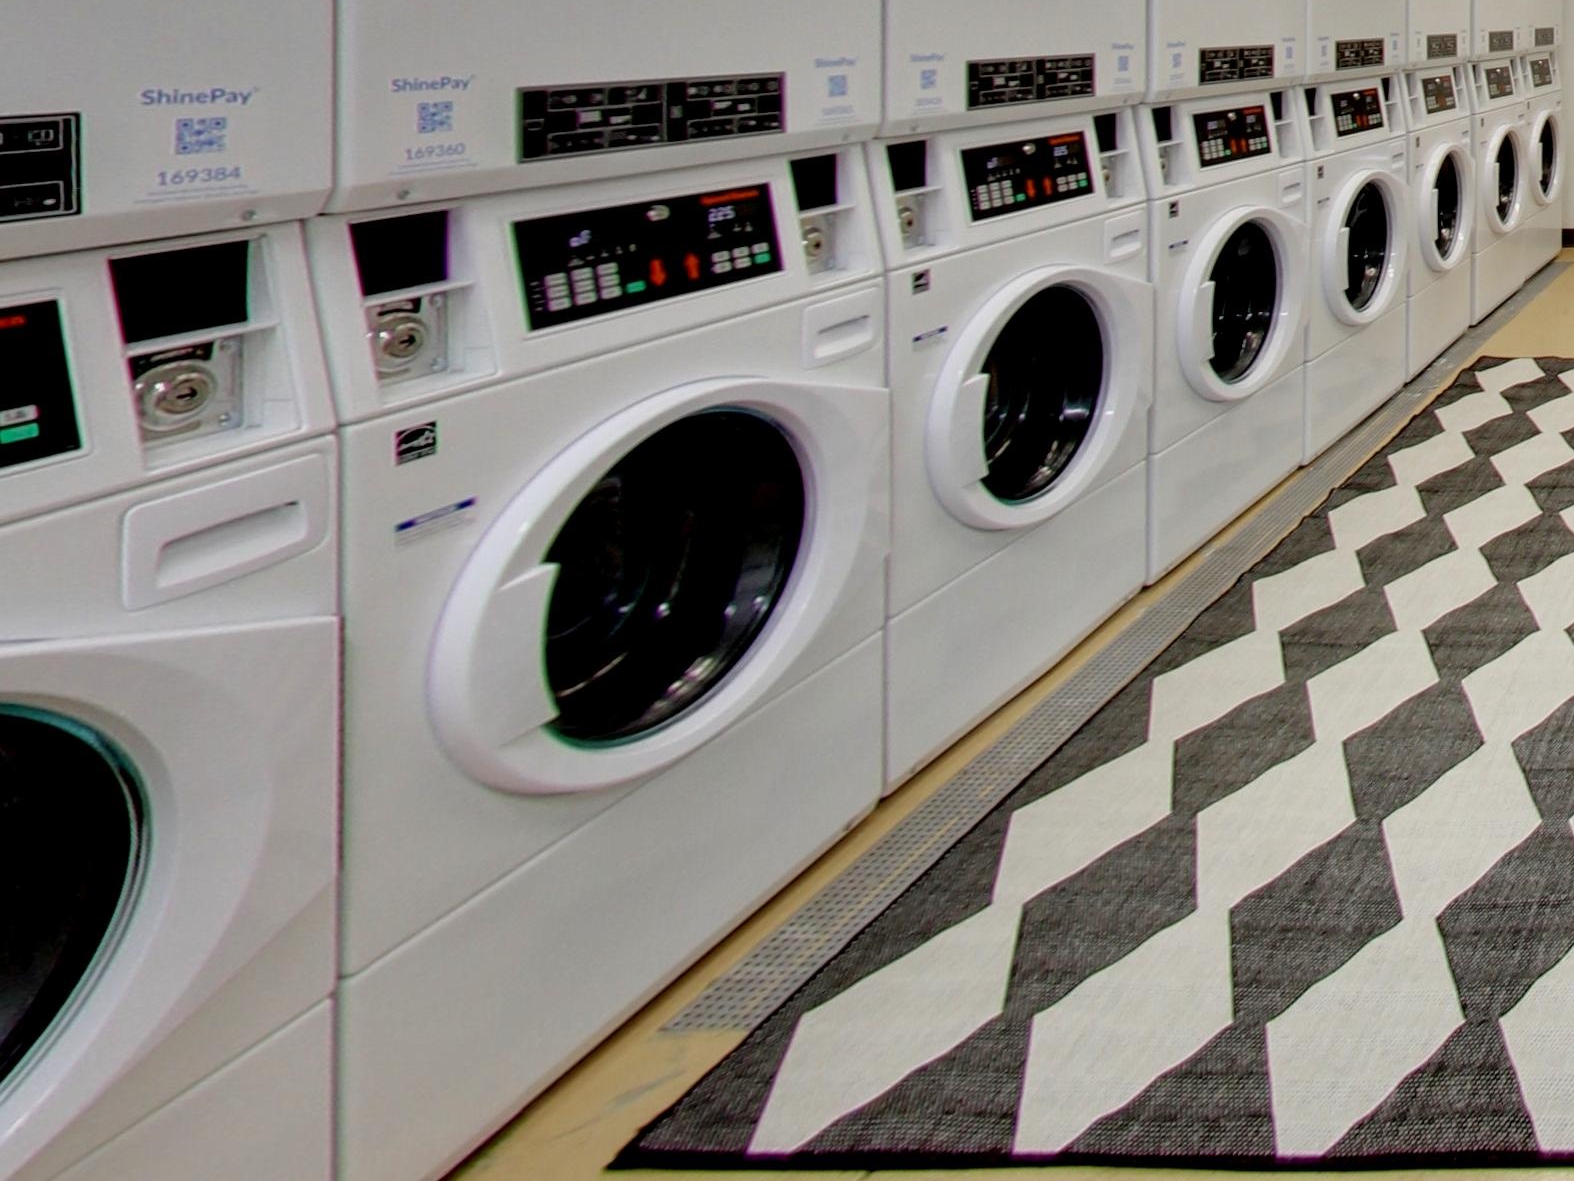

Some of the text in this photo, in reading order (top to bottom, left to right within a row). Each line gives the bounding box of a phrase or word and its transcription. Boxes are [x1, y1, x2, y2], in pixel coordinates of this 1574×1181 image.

[391, 76, 470, 92] ShinePay
[141, 88, 252, 105] ShinePay
[405, 143, 466, 160] 169360
[158, 167, 241, 186] 169384
